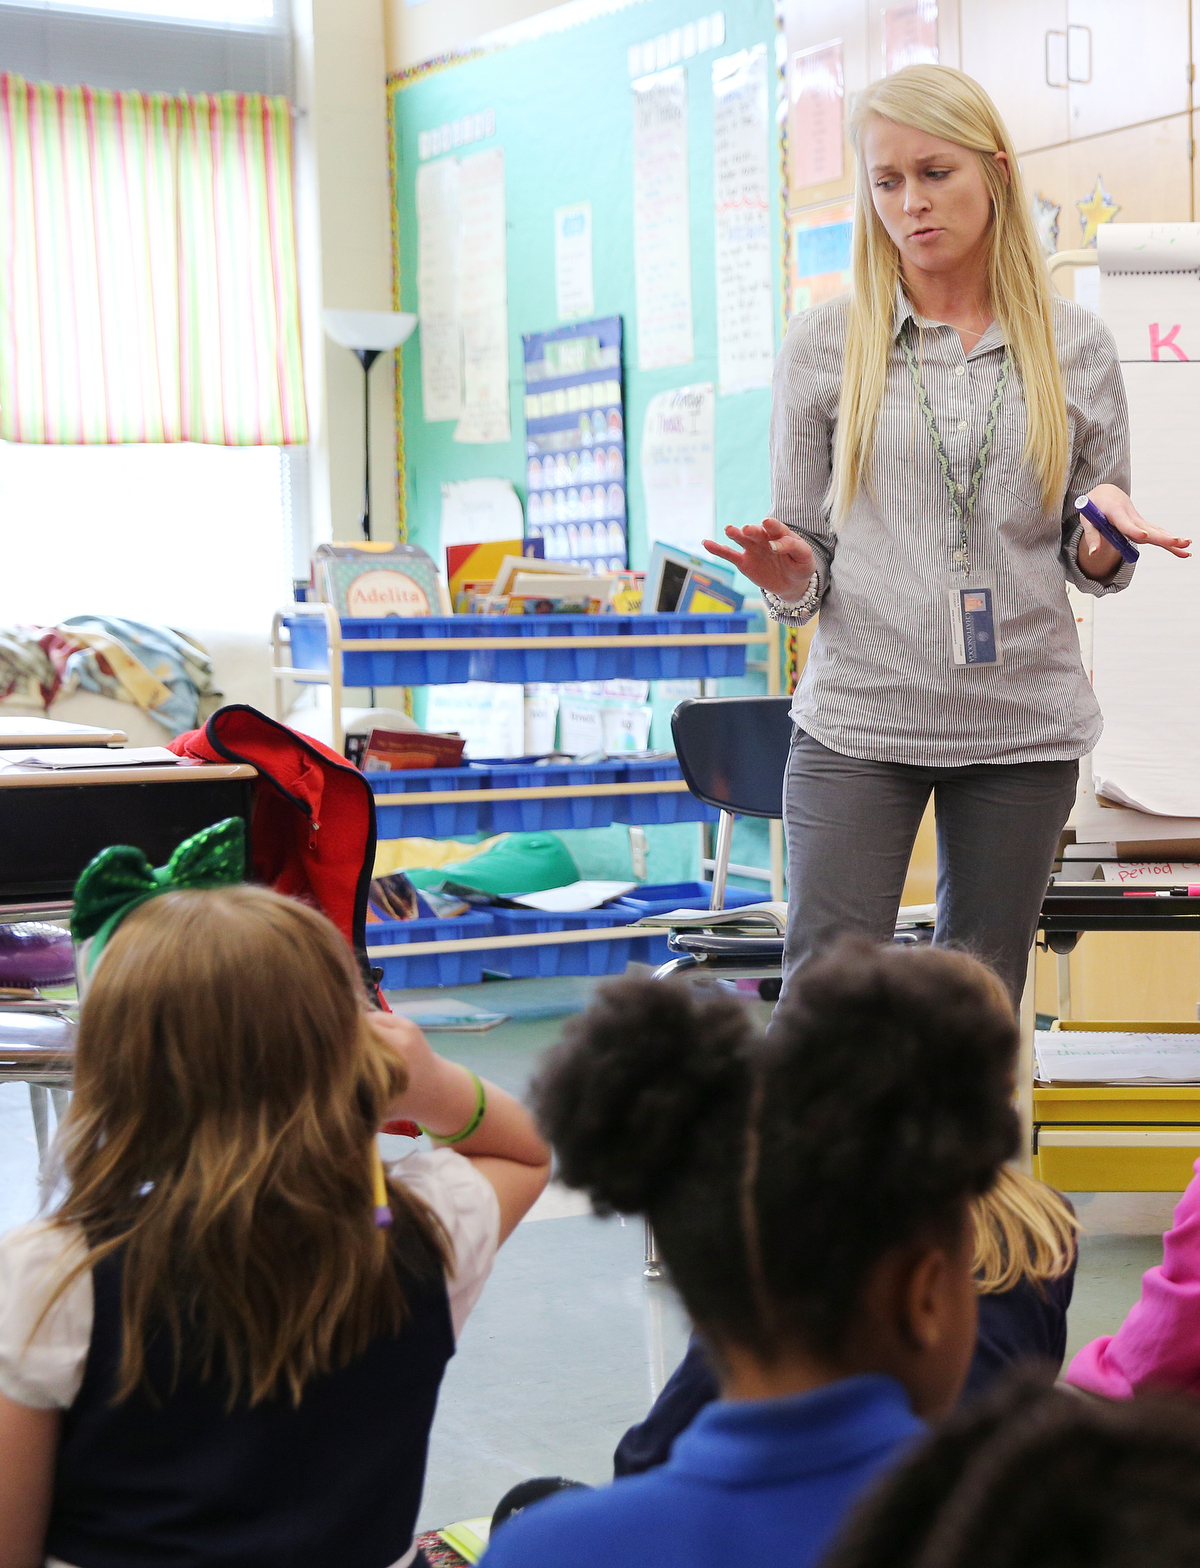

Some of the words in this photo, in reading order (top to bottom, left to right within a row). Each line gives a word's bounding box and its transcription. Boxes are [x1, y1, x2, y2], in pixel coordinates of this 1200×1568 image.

[1148, 322, 1189, 361] K
[354, 588, 419, 603] Adelita
[1118, 865, 1173, 882] period
